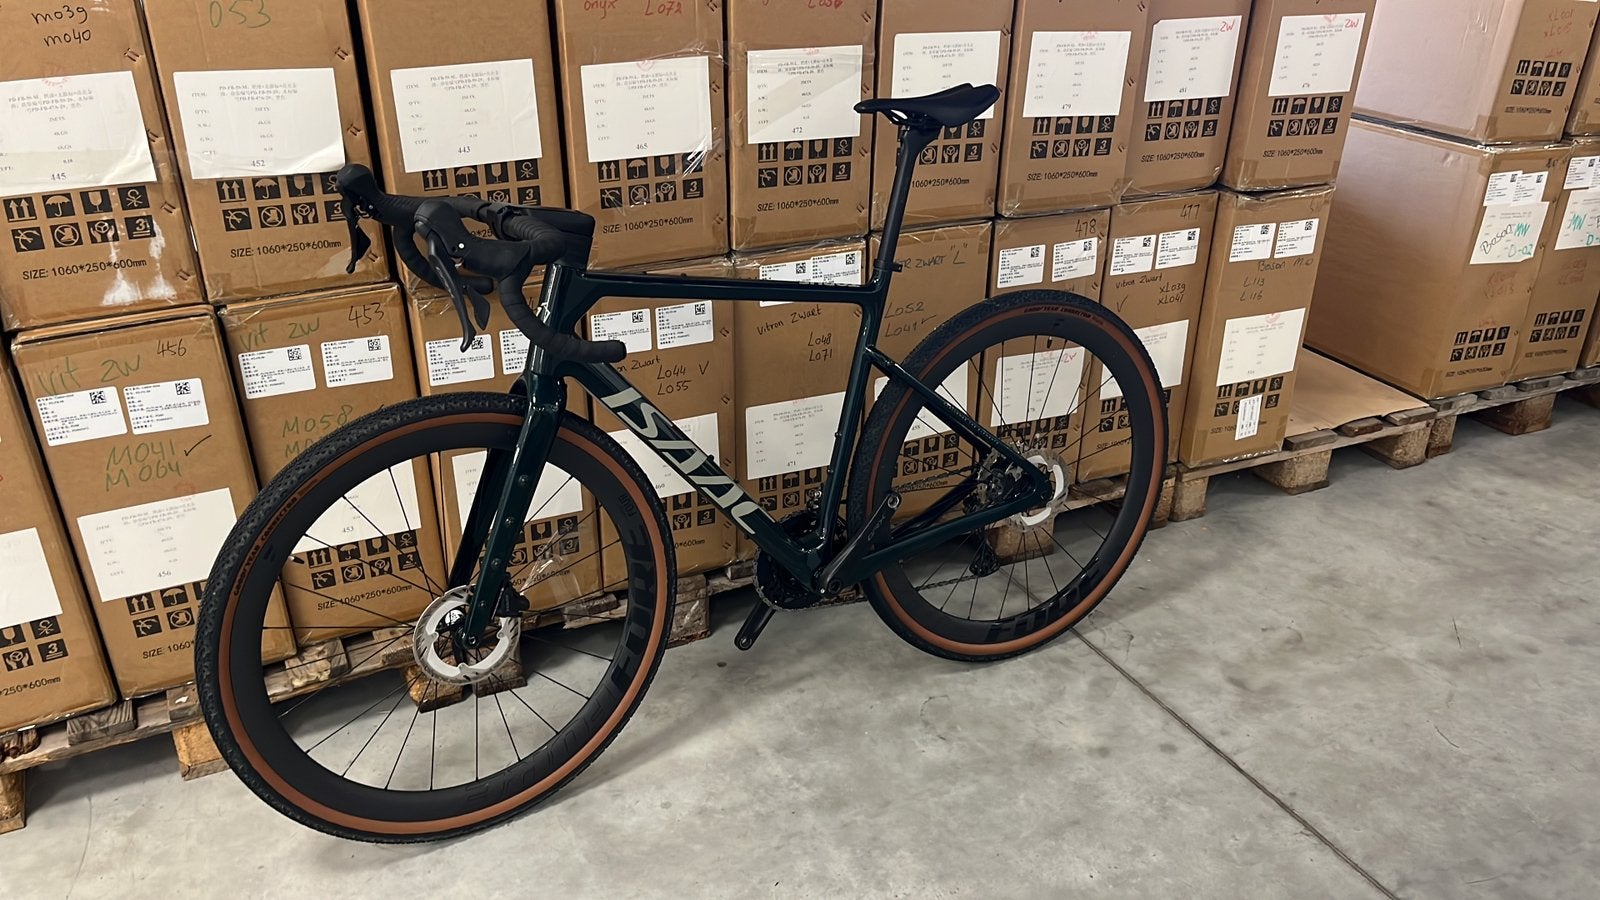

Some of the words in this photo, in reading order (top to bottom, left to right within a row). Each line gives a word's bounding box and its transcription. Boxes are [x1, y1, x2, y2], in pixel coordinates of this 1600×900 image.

[230, 247, 255, 258] SIZE:
[22, 269, 49, 281] SIZE:
[601, 387, 760, 535] ISAAC
